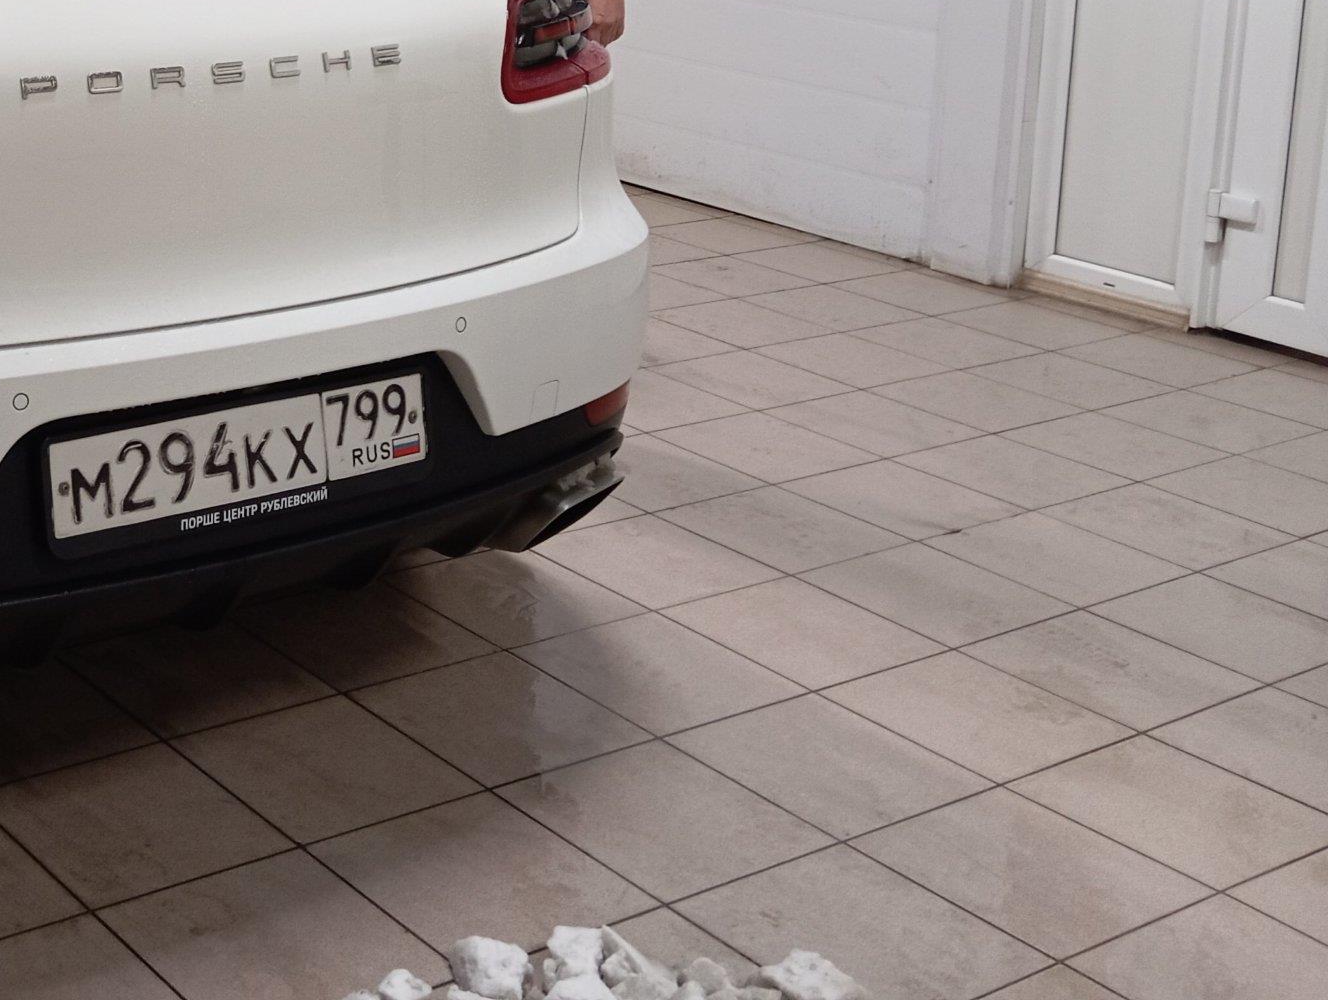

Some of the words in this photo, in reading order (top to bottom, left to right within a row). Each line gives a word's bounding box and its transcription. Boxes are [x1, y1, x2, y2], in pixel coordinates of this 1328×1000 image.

[20, 44, 401, 100] PORSCHE
[325, 383, 407, 447] 799
[352, 443, 391, 467] RUS
[180, 511, 221, 531] ПОРШЕ
[223, 504, 258, 523] ЦЕНТР
[260, 486, 328, 514] РУБЛЕВСКИЙ
